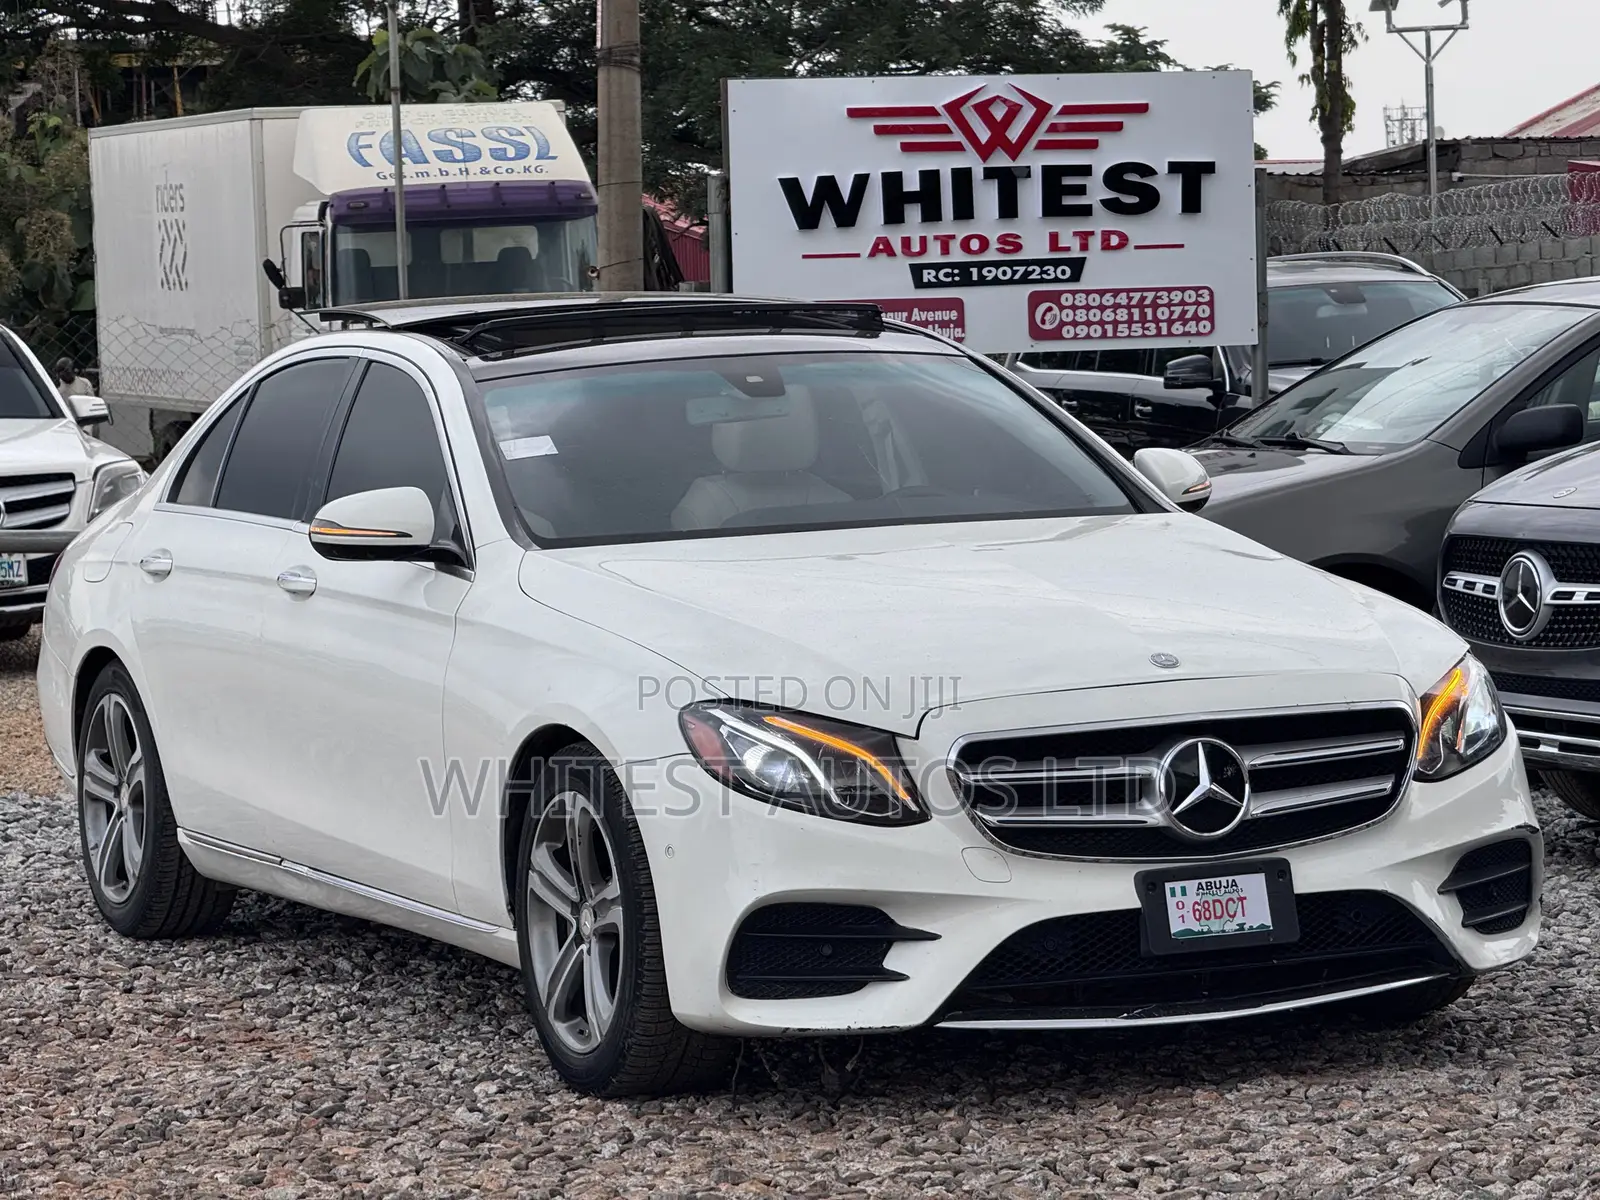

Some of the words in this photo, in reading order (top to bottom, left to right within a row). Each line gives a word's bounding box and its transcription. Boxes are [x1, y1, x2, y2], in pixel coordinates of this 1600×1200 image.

[778, 160, 1216, 231] WHITEST
[867, 233, 1024, 258] AUTOS
[1048, 229, 1129, 253] LTD
[922, 268, 960, 283] RC:
[969, 265, 1072, 281] 1907230
[1060, 289, 1210, 307] 08064773903
[910, 307, 958, 322] Avenue
[1060, 304, 1211, 323] 08068110770
[1061, 319, 1212, 339] 09015531640
[1196, 879, 1239, 892] ABUJA
[1192, 896, 1247, 922] 68DCT
